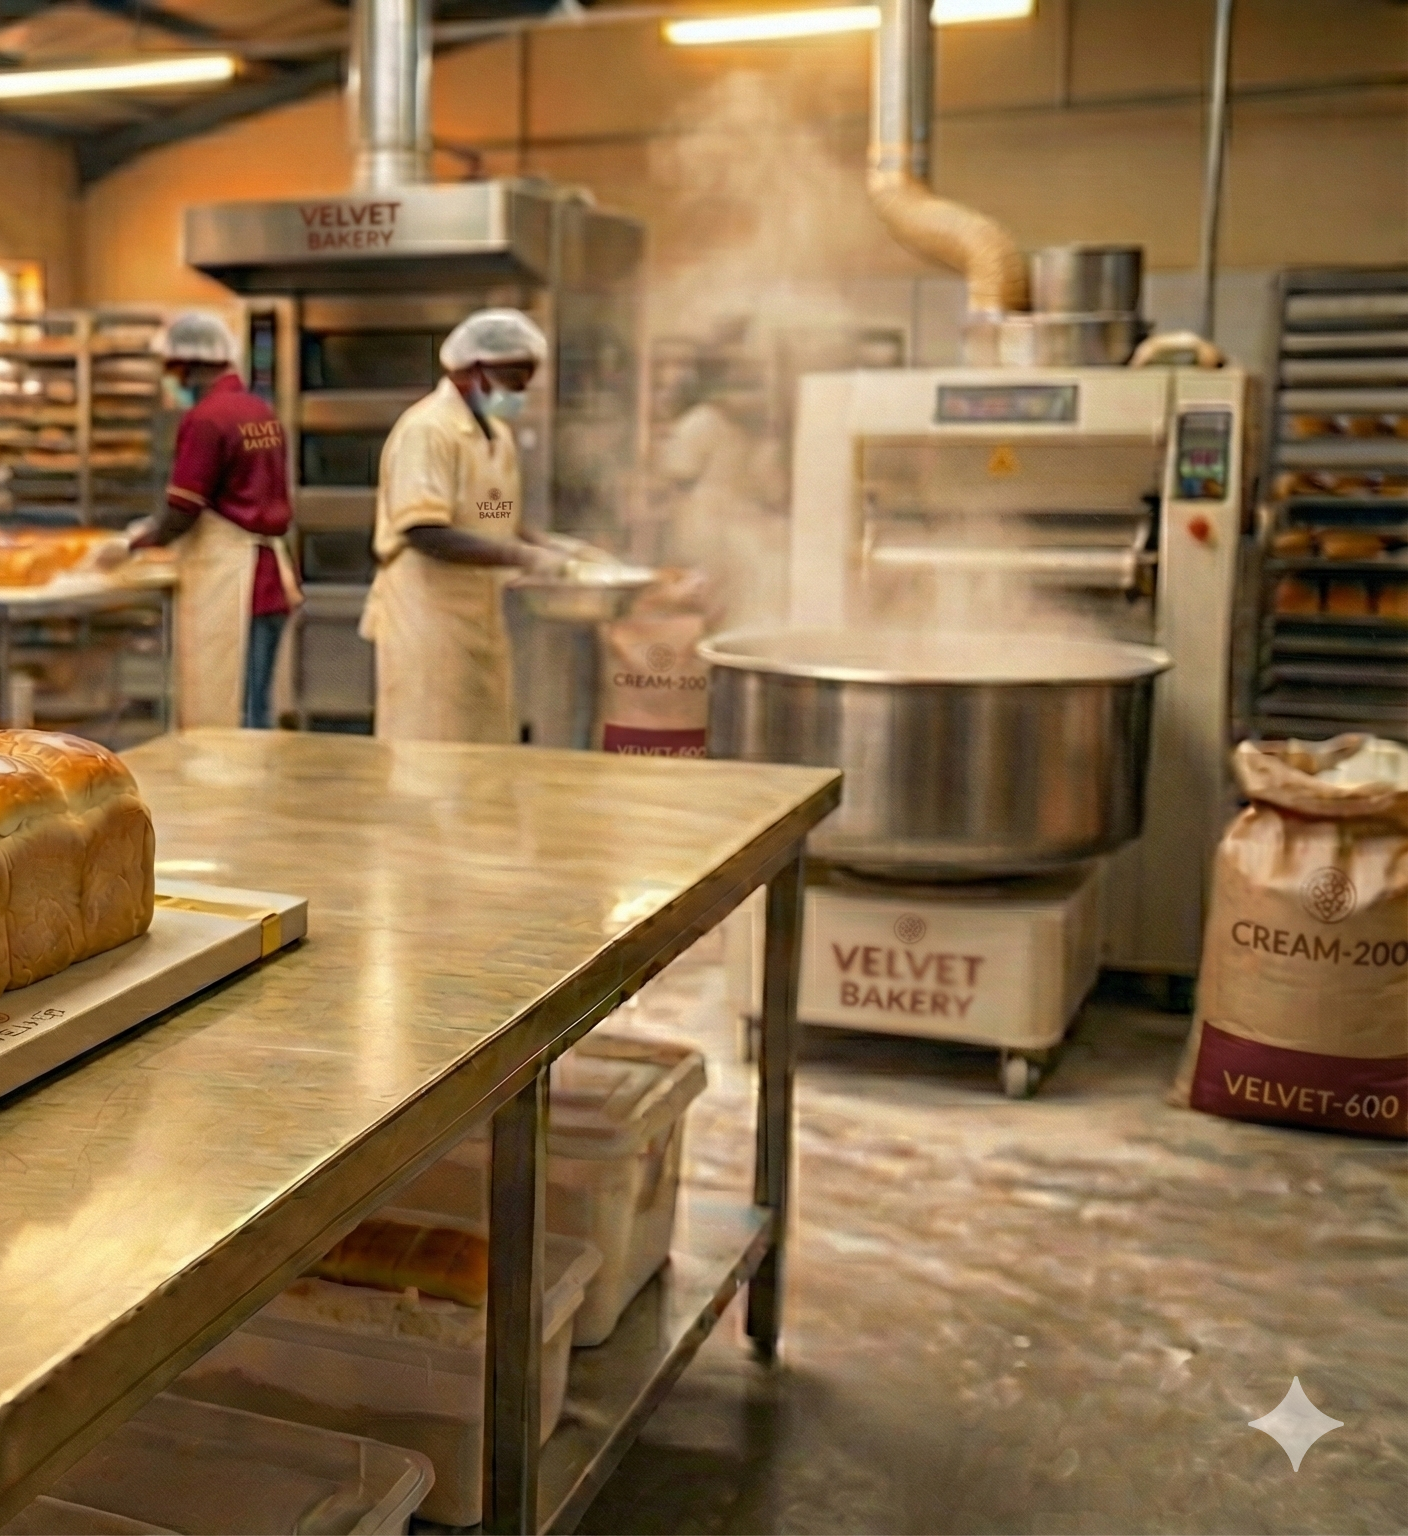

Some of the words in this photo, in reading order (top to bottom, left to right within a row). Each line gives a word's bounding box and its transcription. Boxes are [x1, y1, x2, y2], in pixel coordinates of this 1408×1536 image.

[299, 202, 401, 227] VELVET
[308, 230, 394, 250] BAKERY
[613, 673, 707, 690] CREAM-200
[1231, 921, 1408, 967] CREAM-200
[832, 943, 985, 987] VELVET
[840, 981, 973, 1018] BAKERY
[1223, 1069, 1399, 1119] VELVET-600
